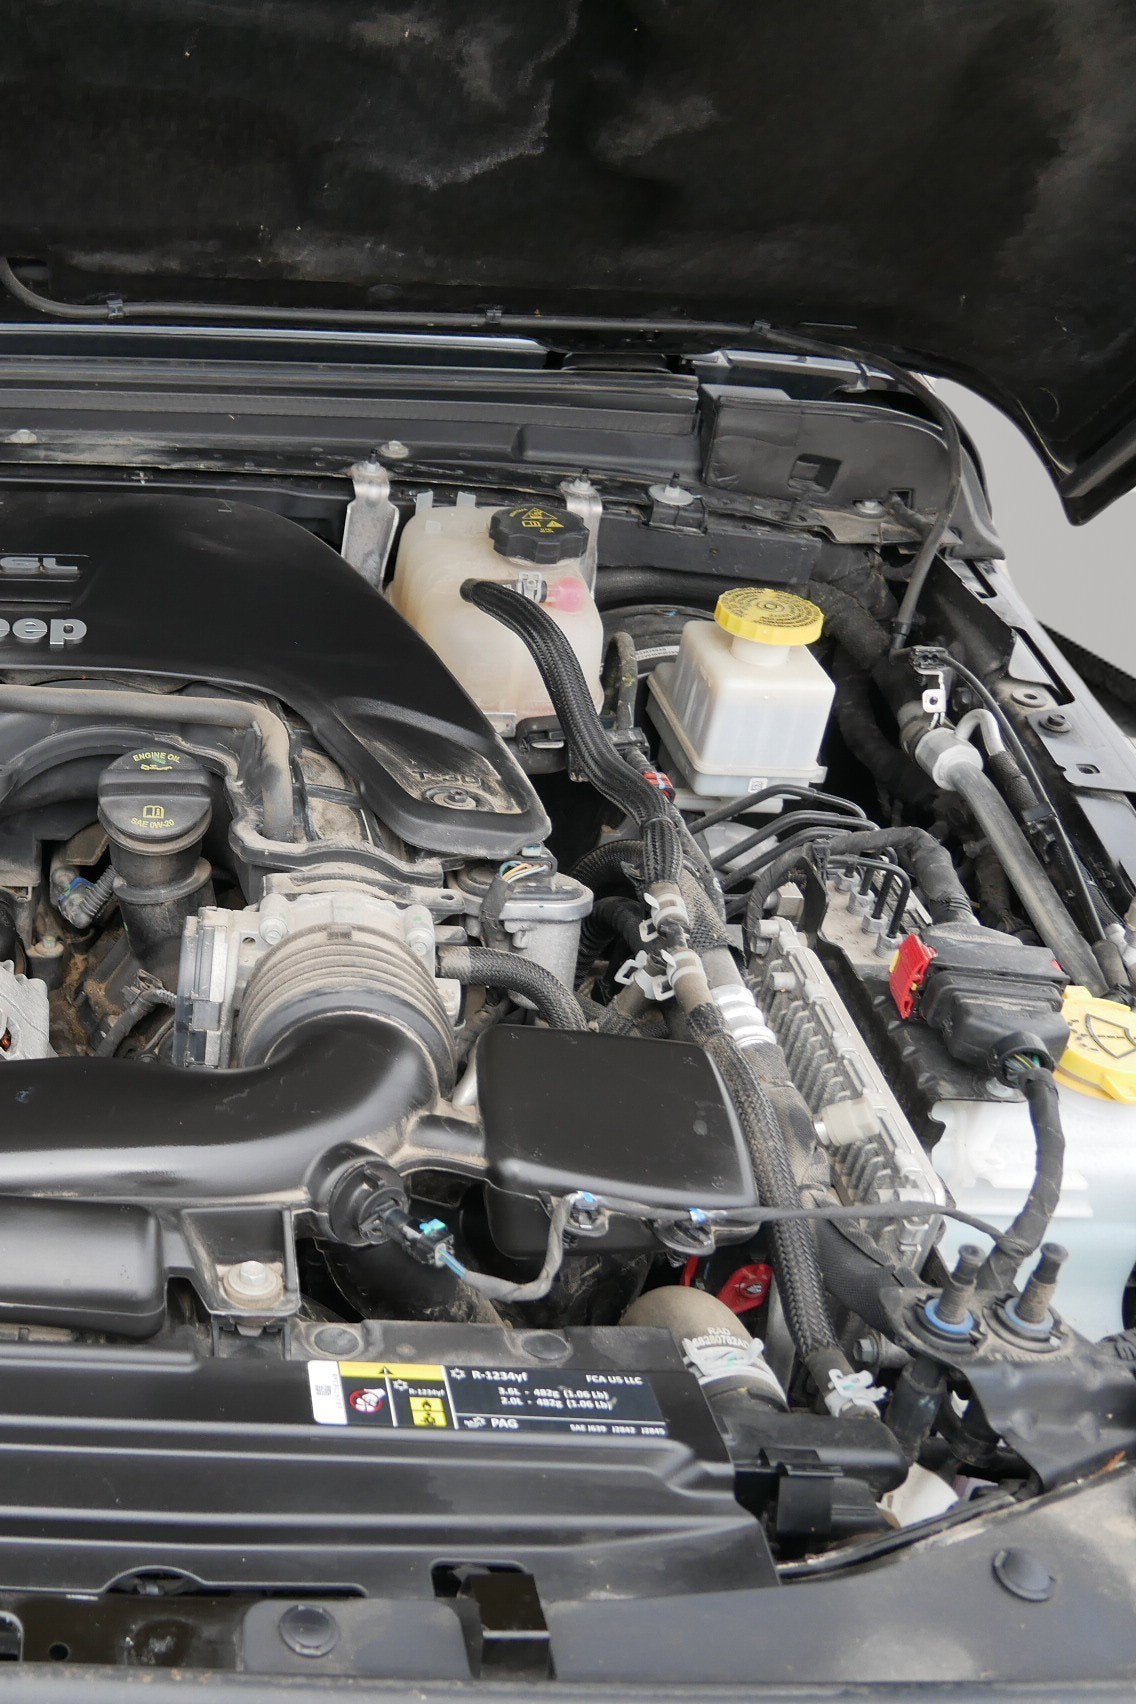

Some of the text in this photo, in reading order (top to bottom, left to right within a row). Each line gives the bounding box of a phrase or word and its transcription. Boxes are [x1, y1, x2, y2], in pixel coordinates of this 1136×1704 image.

[132, 751, 182, 764] ENGINE OIL
[130, 817, 176, 830] SAE 0W-20
[706, 1326, 731, 1336] RAD
[471, 1370, 529, 1383] R-1234yf
[585, 1374, 644, 1386] FCA US LLC
[498, 1386, 522, 1397] 3.6L
[500, 1396, 525, 1407] 2.0L
[490, 1418, 520, 1430] PAG
